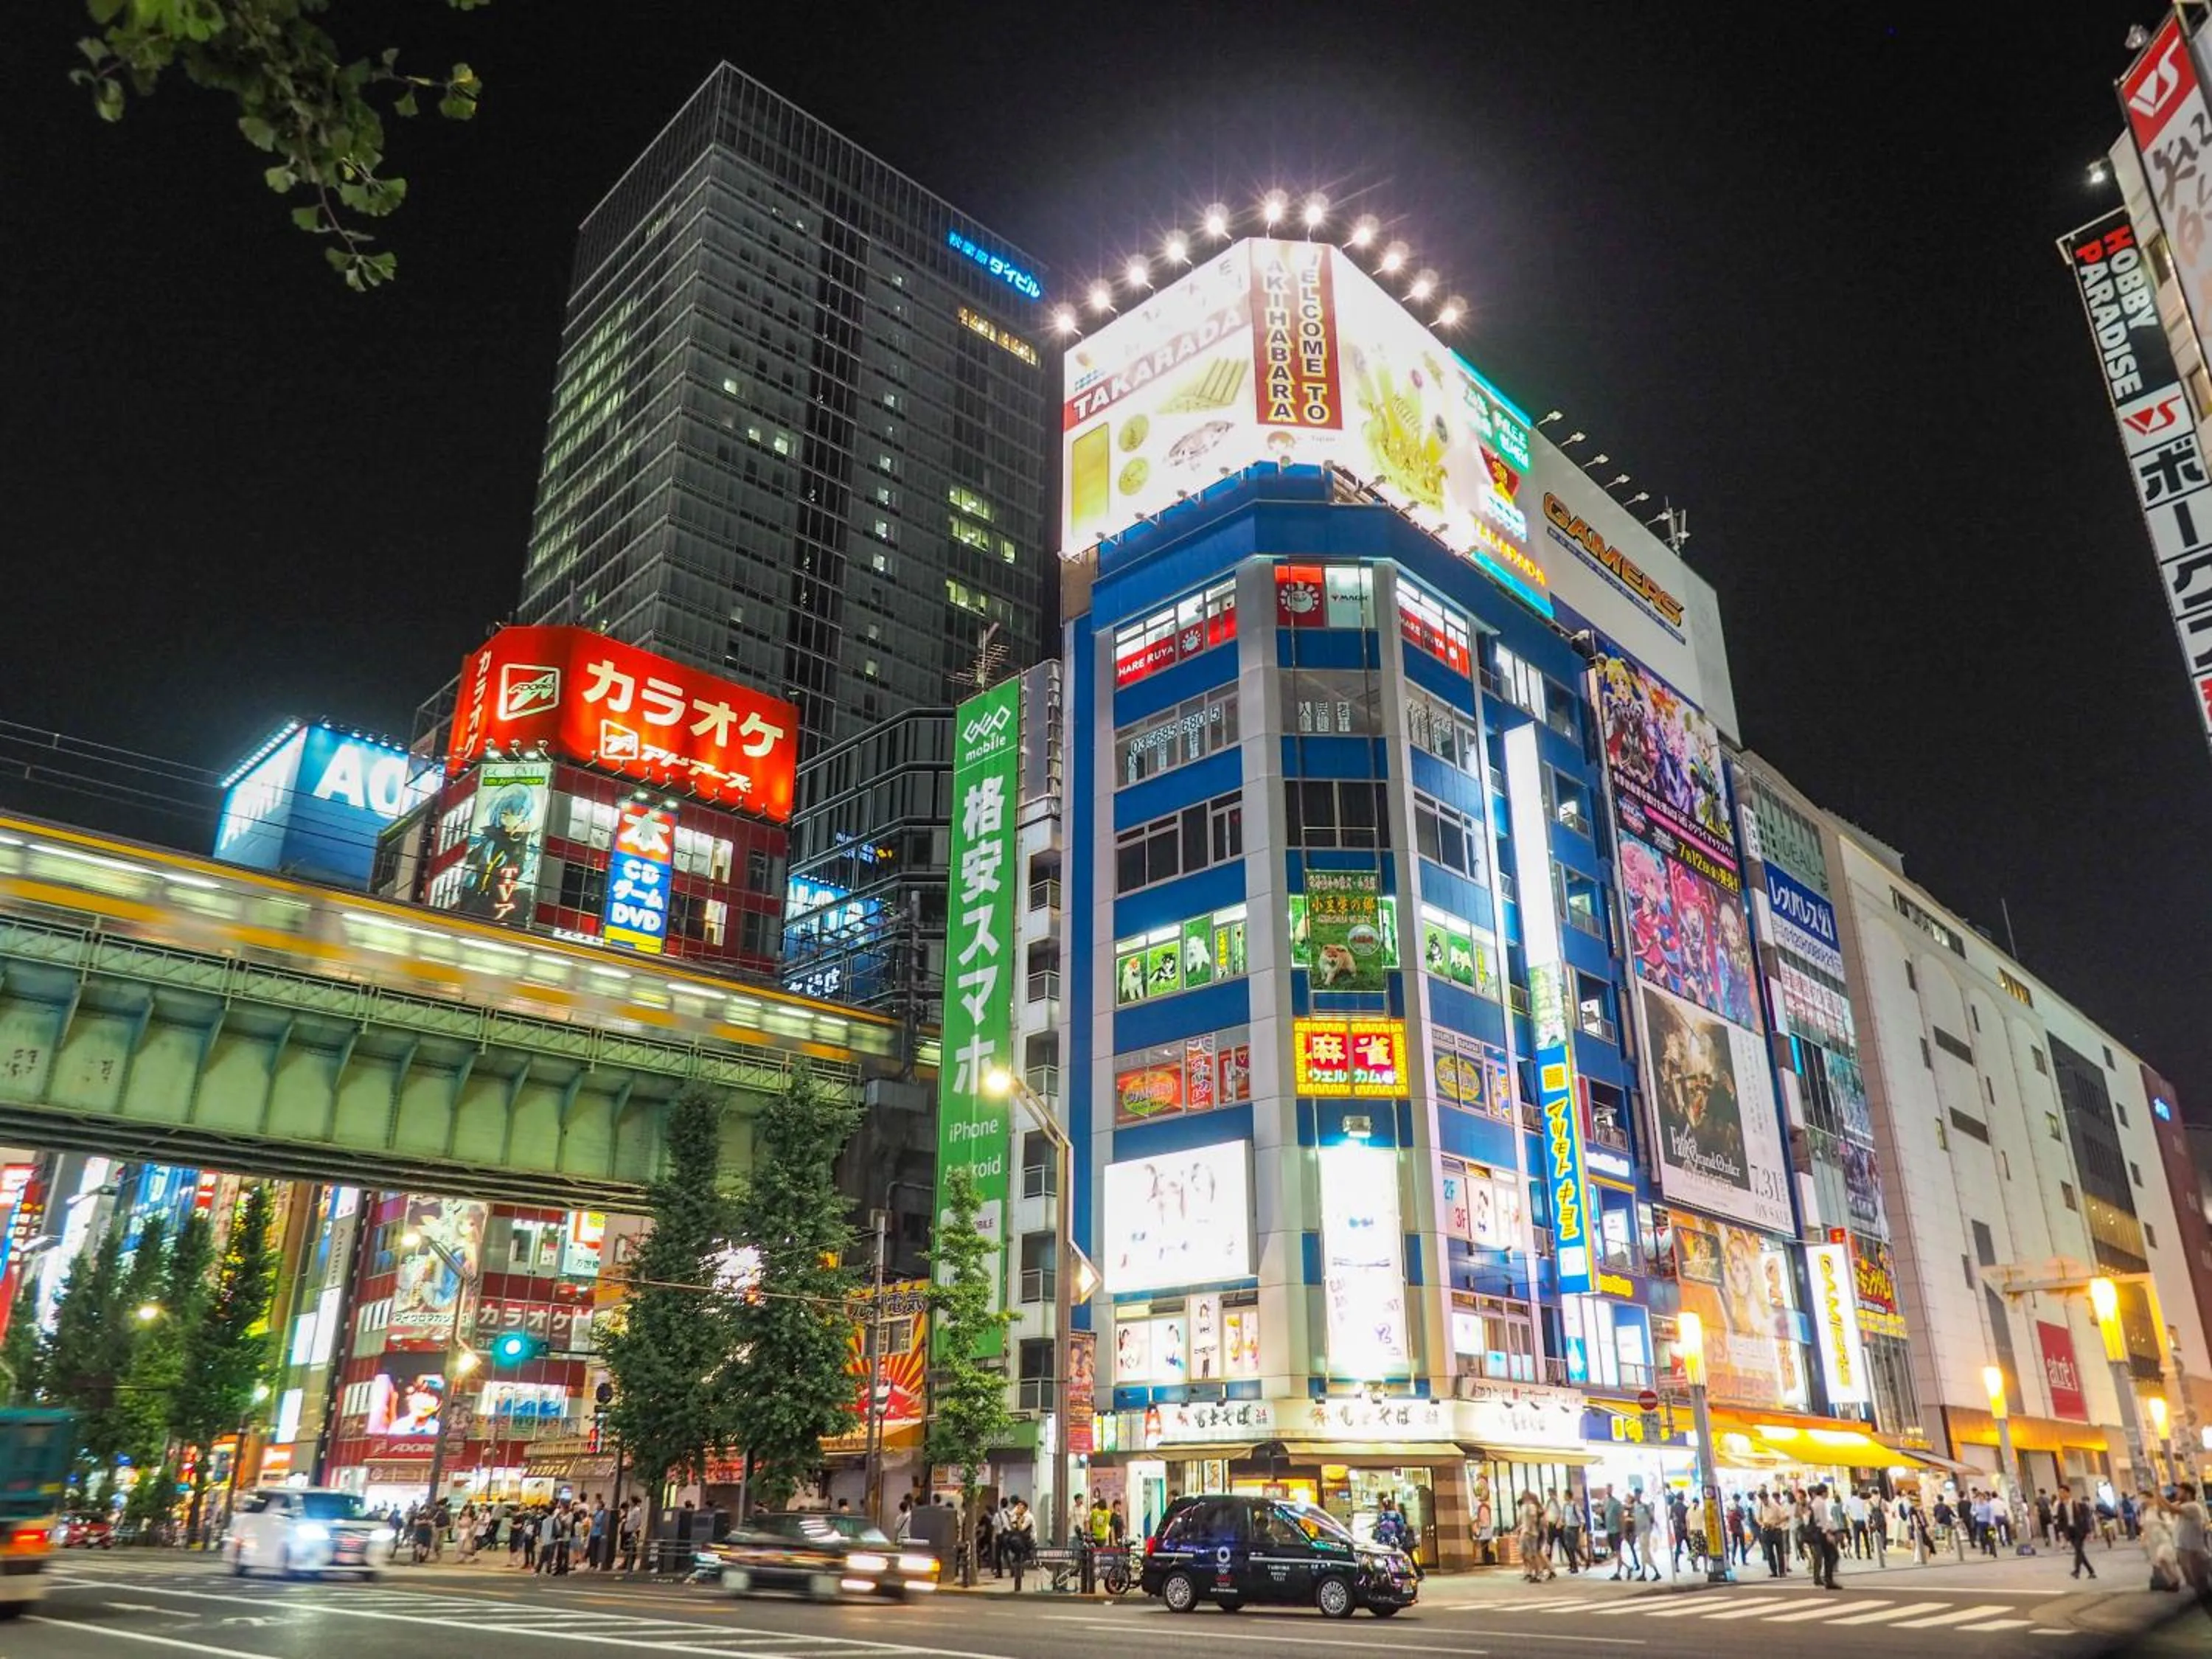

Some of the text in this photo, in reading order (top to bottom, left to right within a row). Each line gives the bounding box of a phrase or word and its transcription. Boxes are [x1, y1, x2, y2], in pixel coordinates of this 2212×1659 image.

[2104, 224, 2158, 330] HOBBY
[1266, 260, 1291, 420] AKIHABARA
[2076, 239, 2143, 400] PARADISE
[1073, 305, 1242, 420] TAKARADA
[1307, 385, 1326, 421] TO
[1543, 492, 1684, 628] GAMERS
[1118, 645, 1175, 678] HARE RUYA
[463, 650, 493, 760] カラオケ
[582, 659, 784, 758] カラオケ
[640, 742, 753, 794] アドアーズ
[965, 732, 1006, 762] mobile
[619, 809, 670, 854] 本
[613, 879, 664, 911] ゲーム
[622, 859, 660, 886] CD
[611, 902, 661, 932] DVD
[952, 776, 1005, 1097] 格安スマホ
[1306, 1034, 1391, 1066] 麻雀
[949, 1118, 998, 1143] iPhone
[479, 1303, 568, 1330] カラオケ
